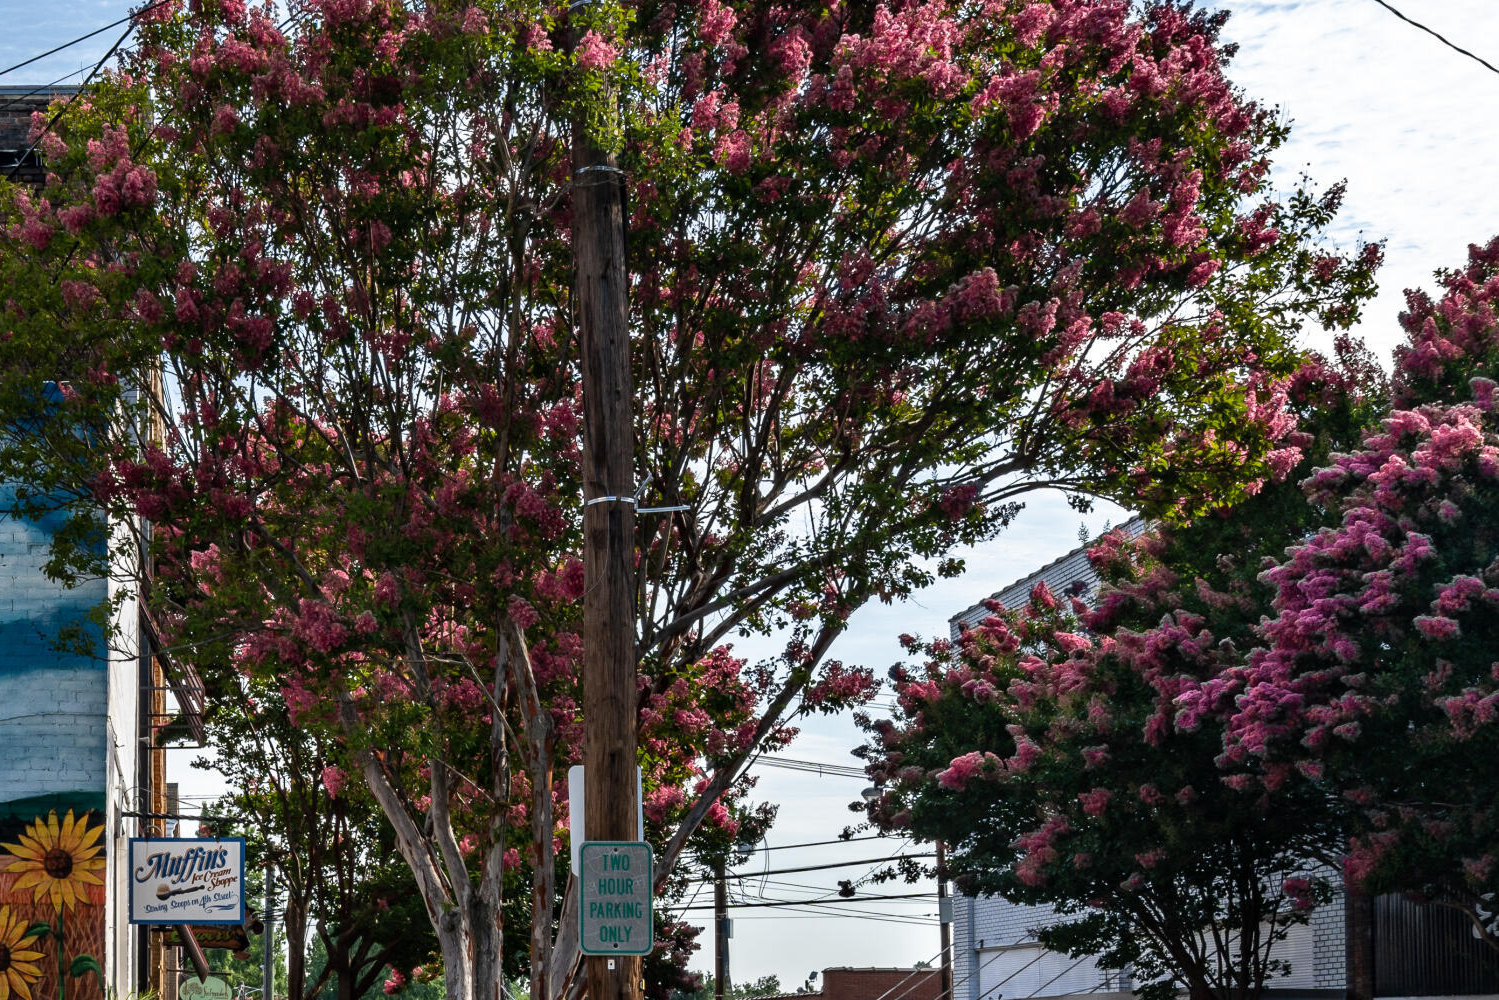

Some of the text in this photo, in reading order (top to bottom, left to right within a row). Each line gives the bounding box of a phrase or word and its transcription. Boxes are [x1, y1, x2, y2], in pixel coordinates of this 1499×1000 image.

[134, 845, 228, 885] Muffin's
[603, 854, 630, 871] TWO
[191, 868, 232, 884] Ice Cream
[207, 876, 238, 892] Shoppe
[598, 878, 633, 895] HOUR
[589, 902, 643, 919] PARKING
[599, 926, 633, 943] ONLY
